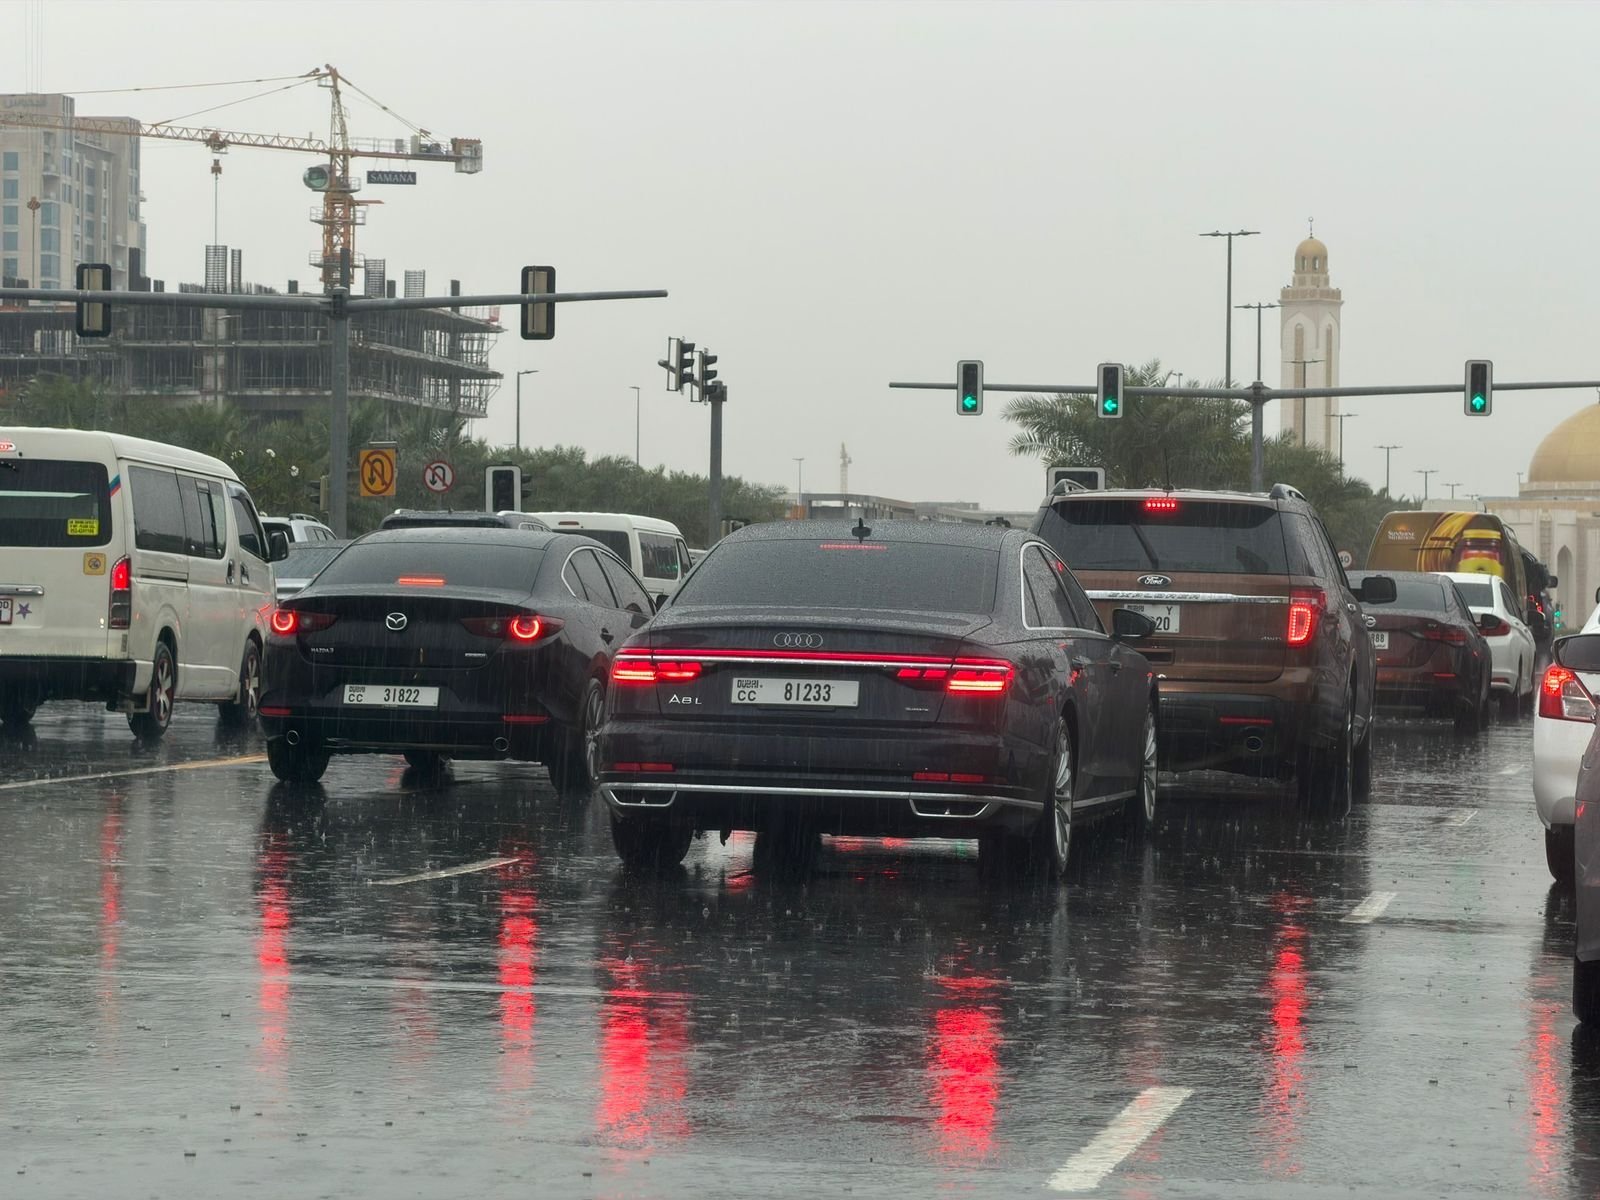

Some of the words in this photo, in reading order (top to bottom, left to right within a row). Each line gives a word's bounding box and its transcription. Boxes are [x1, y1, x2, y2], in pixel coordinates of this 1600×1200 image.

[370, 173, 414, 183] SAMANA
[1144, 575, 1164, 585] Ford
[1166, 606, 1173, 615] Y
[1154, 617, 1170, 631] 20
[348, 693, 364, 703] CC
[383, 688, 420, 703] 31822
[737, 690, 757, 702] CC
[784, 682, 832, 702] 81233
[669, 694, 692, 704] A8
